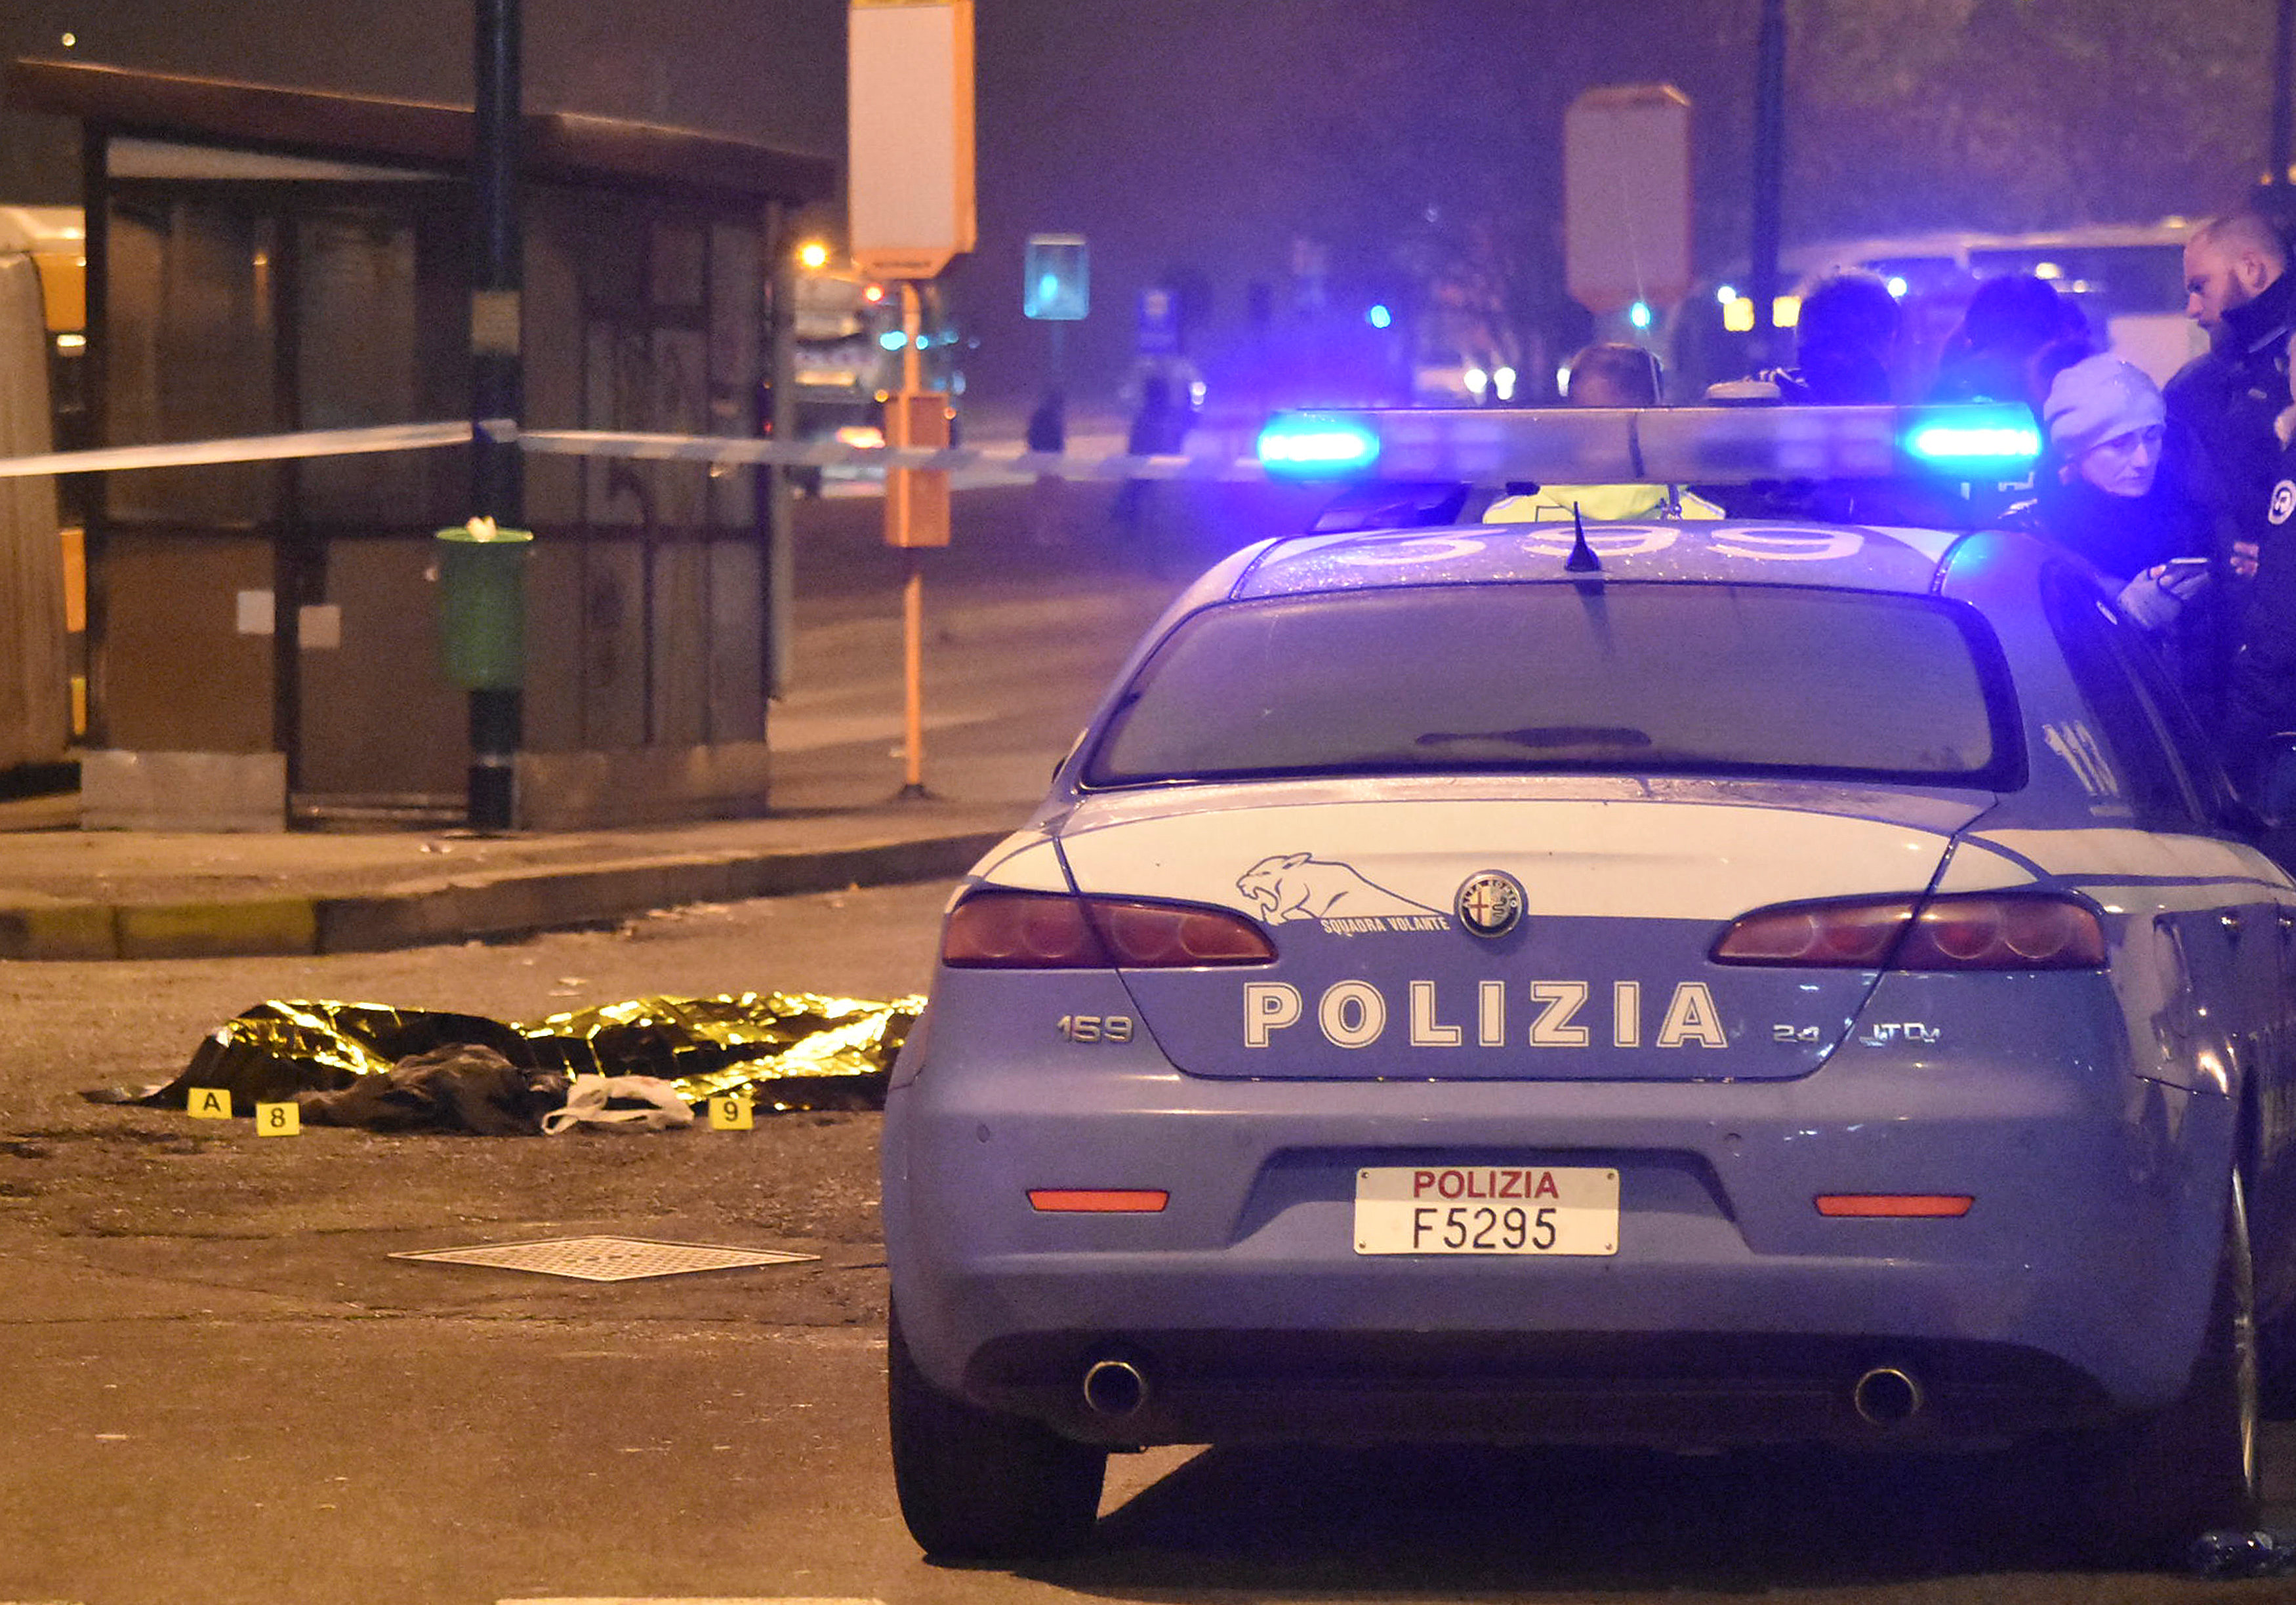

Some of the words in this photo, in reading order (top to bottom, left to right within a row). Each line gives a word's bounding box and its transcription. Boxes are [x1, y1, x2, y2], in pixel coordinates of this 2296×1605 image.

[1321, 918, 1386, 935] SQUADRA
[1387, 917, 1450, 931] VOLANTE
[1244, 980, 1728, 1048] POLIZIA
[1057, 1015, 1134, 1043] 159
[203, 1092, 221, 1112] A
[724, 1101, 738, 1122] 9
[271, 1107, 285, 1128] 8
[1414, 1171, 1559, 1198] POLIZIA
[1414, 1207, 1557, 1249] F5295
